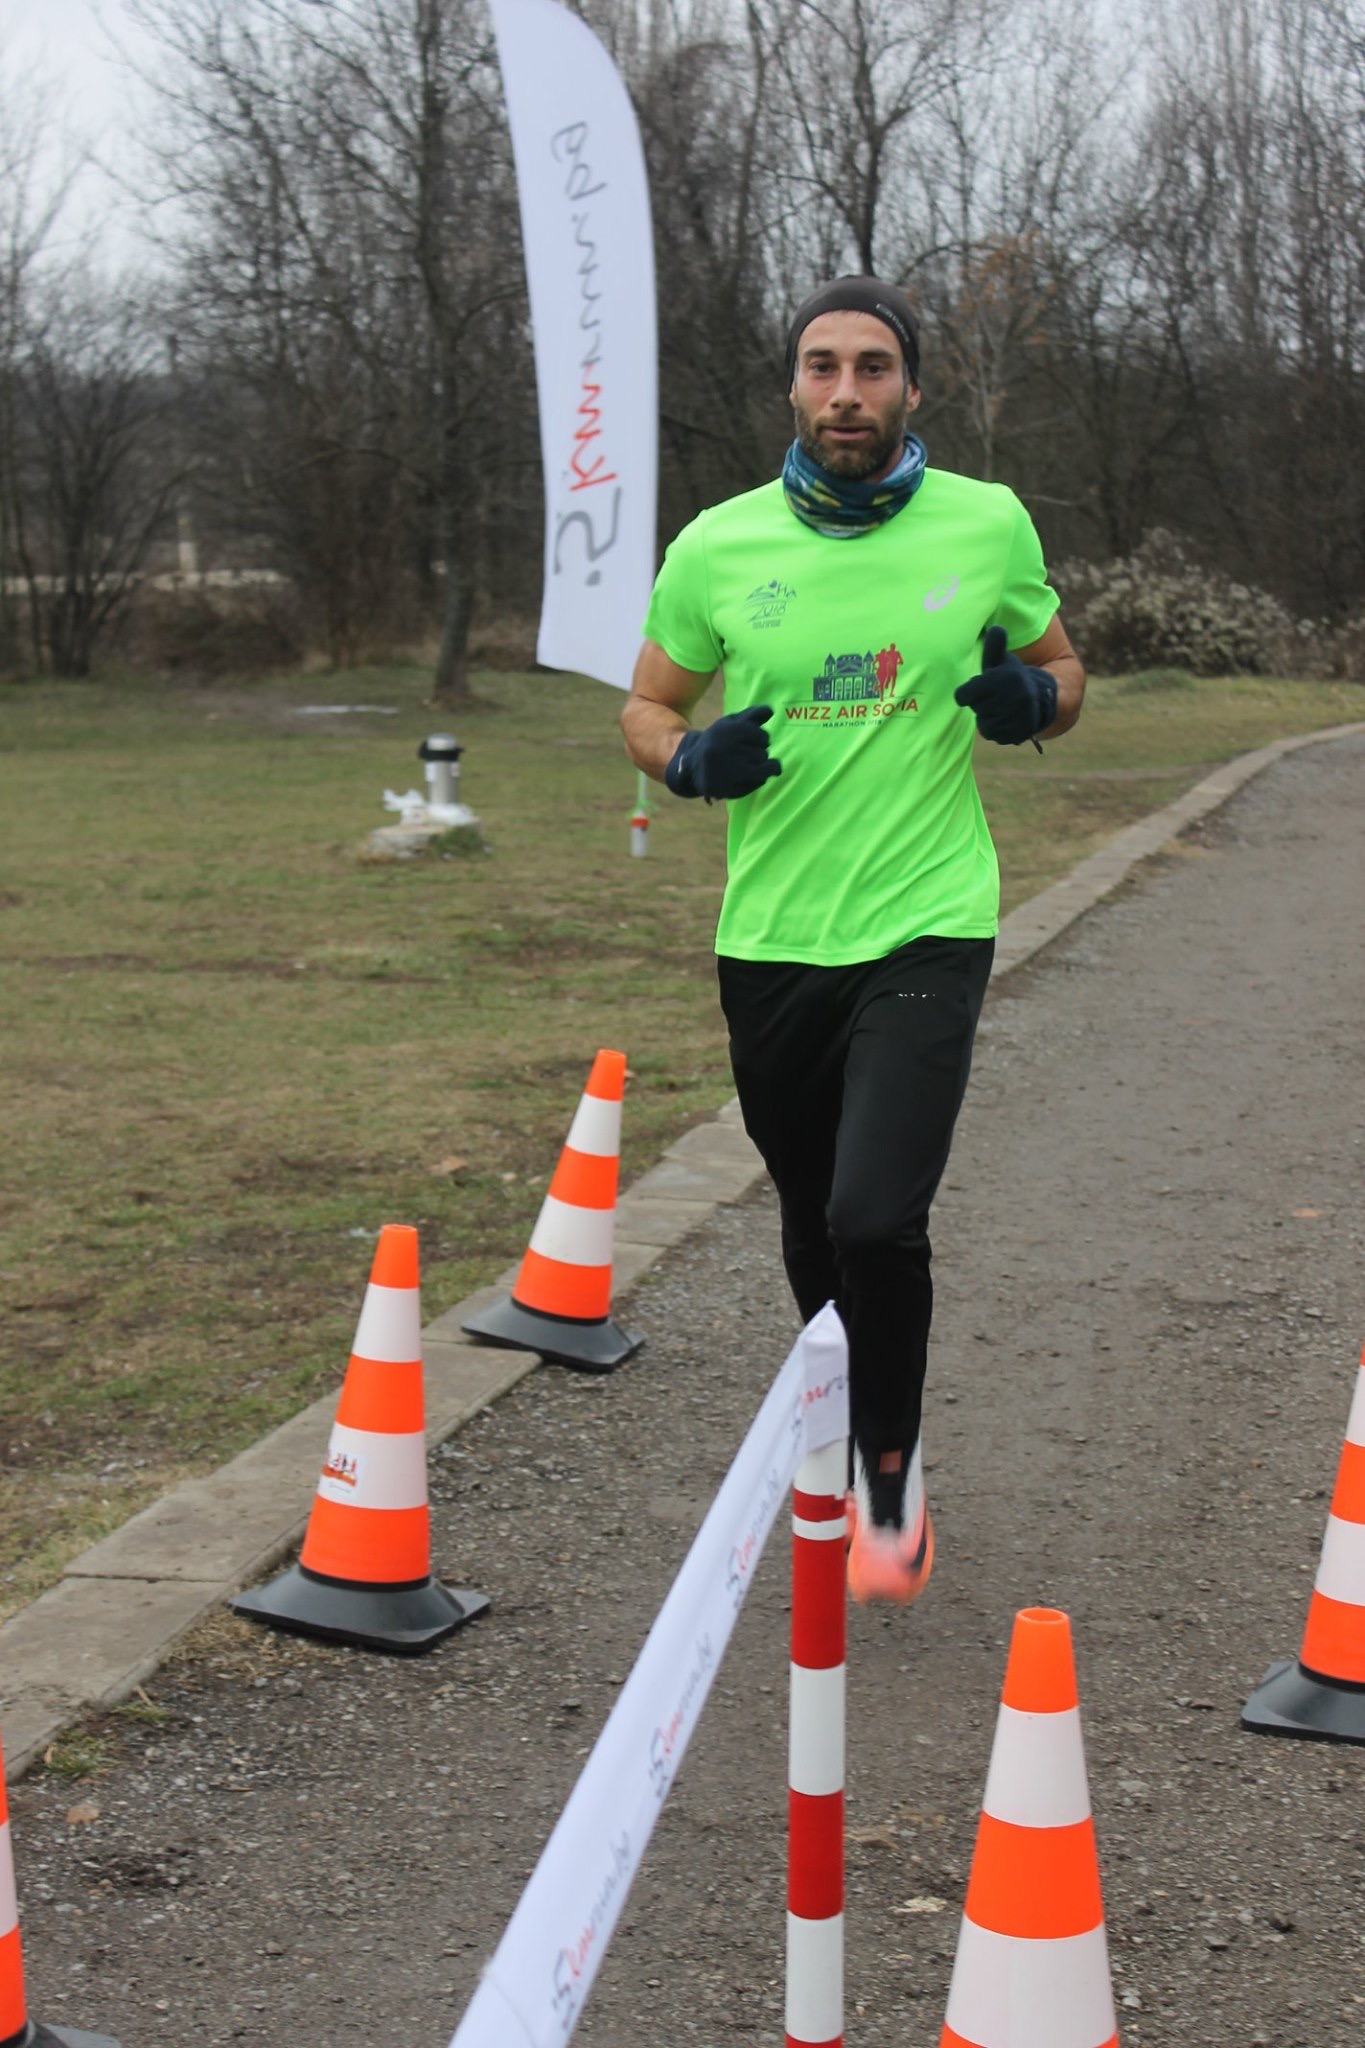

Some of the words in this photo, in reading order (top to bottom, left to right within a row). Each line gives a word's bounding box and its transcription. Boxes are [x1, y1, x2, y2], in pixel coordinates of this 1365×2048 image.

[785, 706, 831, 720] WIZZ
[836, 704, 867, 719] AIR
[822, 720, 866, 728] MARATHON
